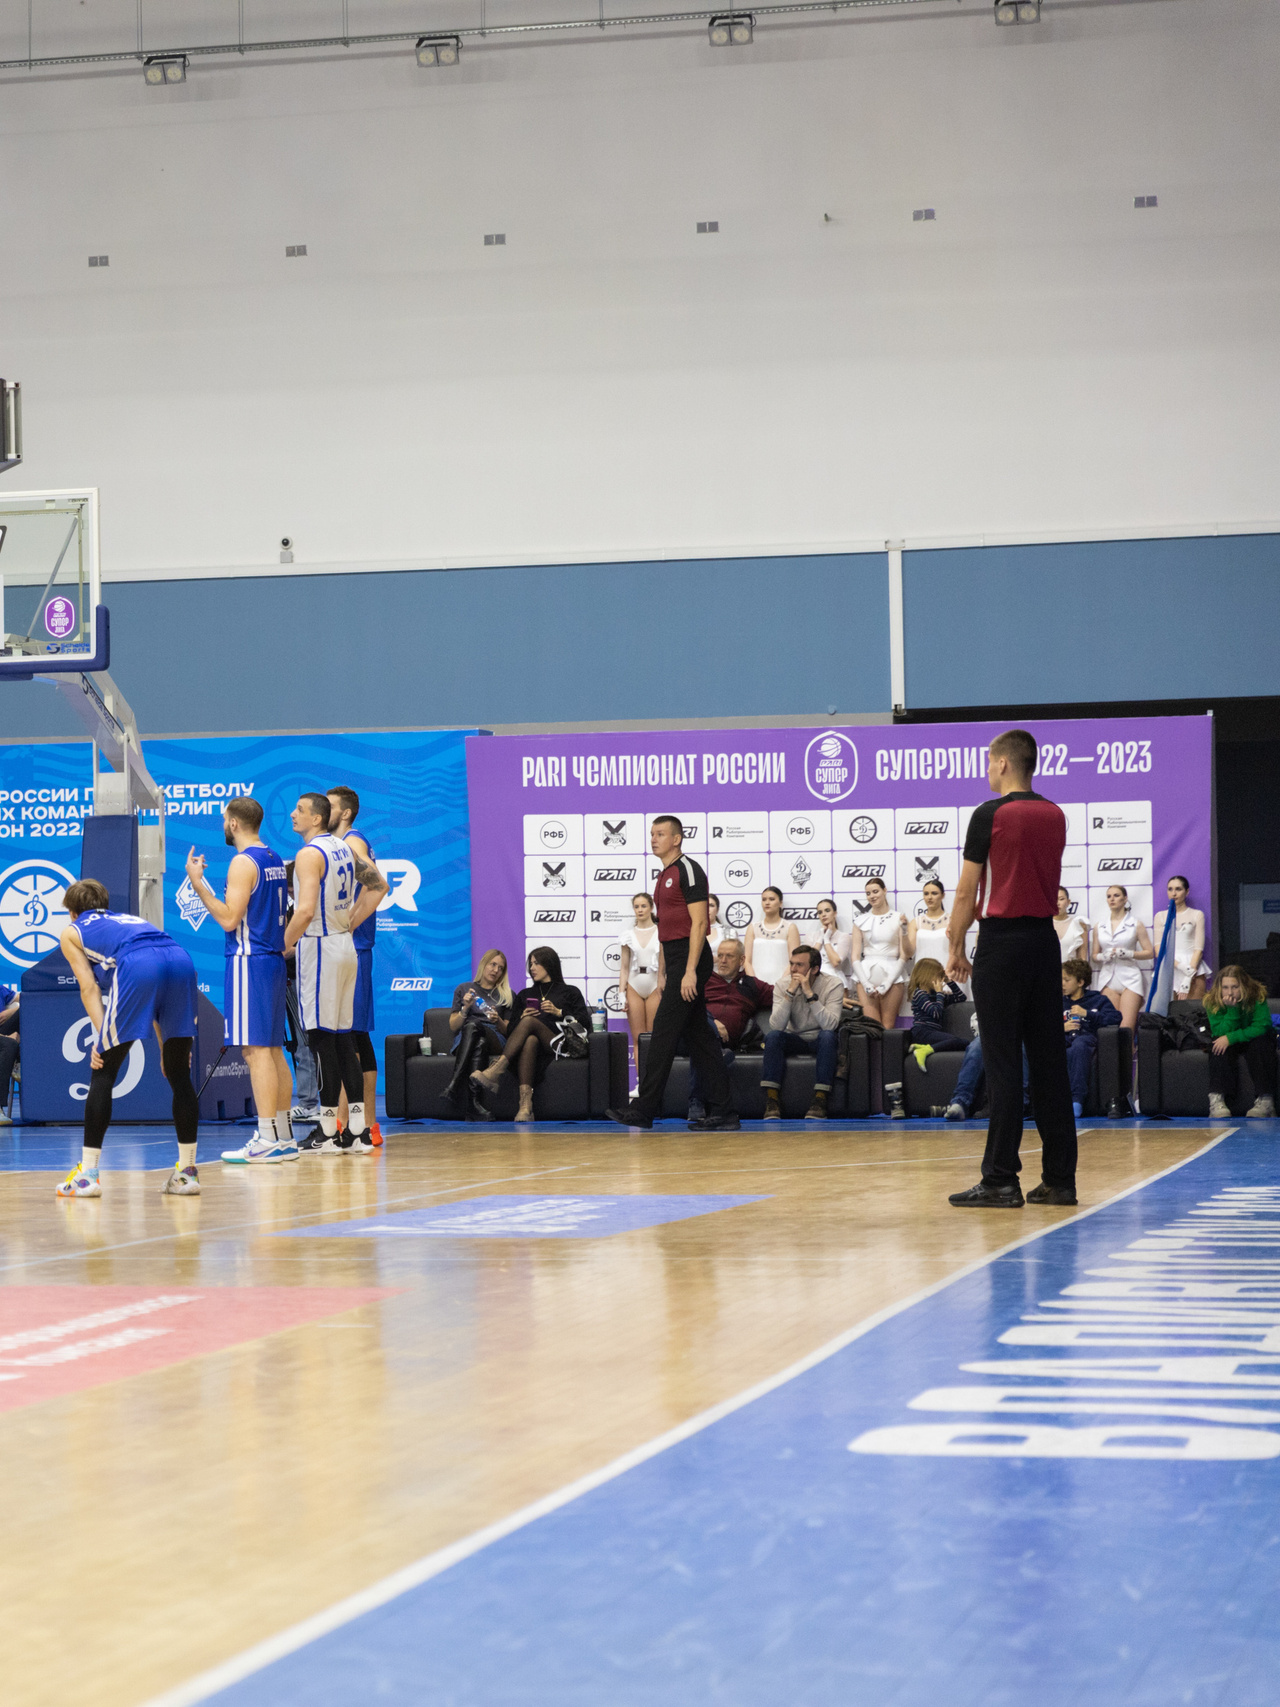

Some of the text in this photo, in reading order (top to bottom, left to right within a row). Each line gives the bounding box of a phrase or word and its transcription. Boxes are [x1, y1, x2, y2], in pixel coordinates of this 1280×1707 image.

[522, 756, 567, 787] PARI
[703, 752, 786, 785] РОССИИ
[875, 746, 989, 781] СУПЕРЛИГ
[21, 804, 94, 821] КОМАН
[790, 827, 811, 835] РФБ
[905, 822, 949, 834] PARI
[543, 830, 564, 839] РФБ
[1098, 858, 1143, 871] PARI
[594, 869, 637, 881] PARI
[728, 869, 749, 878] РФБ
[842, 865, 886, 877] PARI
[534, 910, 576, 922] PARI
[606, 953, 621, 961] РФ
[391, 978, 433, 991] PARI
